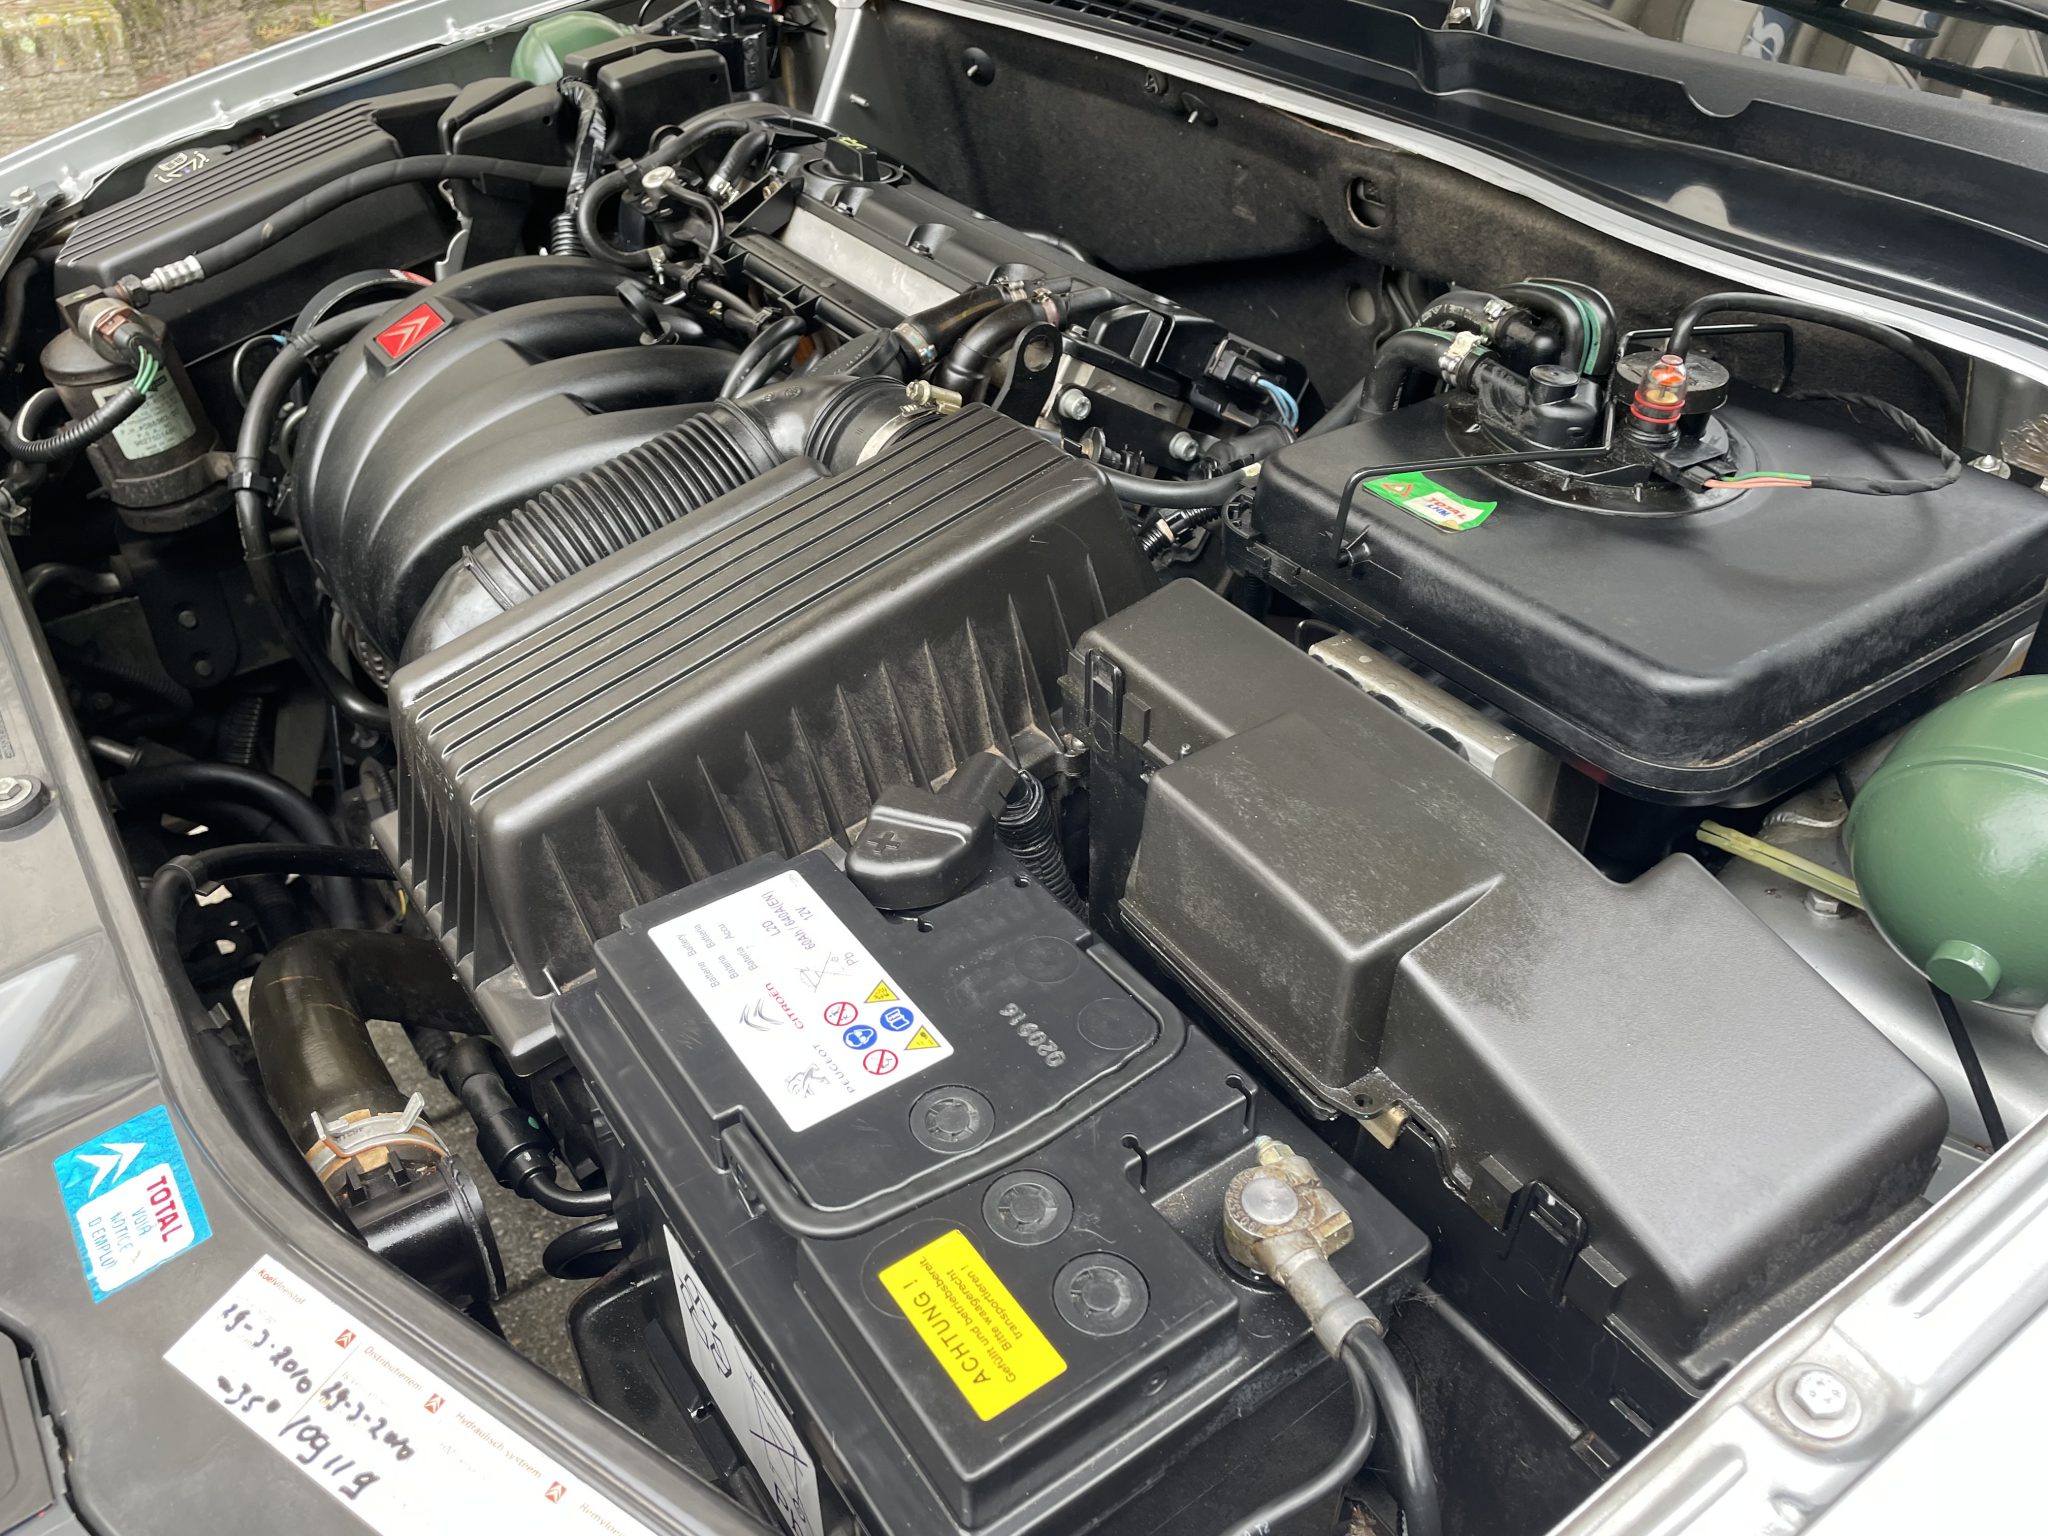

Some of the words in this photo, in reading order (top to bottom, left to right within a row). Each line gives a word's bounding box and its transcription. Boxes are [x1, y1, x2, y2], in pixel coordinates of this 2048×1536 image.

[761, 890, 796, 926] 640A(EN)
[795, 906, 814, 920] 12V
[676, 934, 697, 956] Battery
[718, 923, 735, 939] Accu
[762, 920, 781, 936] L2D
[794, 929, 816, 950] 60Ah
[844, 952, 859, 966] Pb
[812, 1044, 855, 1093] PEUGEOT
[131, 1206, 152, 1236] VOIR
[146, 1175, 183, 1243] TOTAL
[110, 1211, 134, 1252] NOTICE
[919, 1256, 973, 1326] betriebsbereit.
[946, 1269, 992, 1326] waagerecht
[967, 1270, 1023, 1340] transportieren
[913, 1291, 991, 1384] ACHTUNG
[970, 1327, 990, 1346] und
[991, 1326, 1012, 1352] Bitte
[986, 1346, 1017, 1383] Gefüllt
[456, 1411, 505, 1451] Hydraulisch
[505, 1450, 542, 1479] systeem
